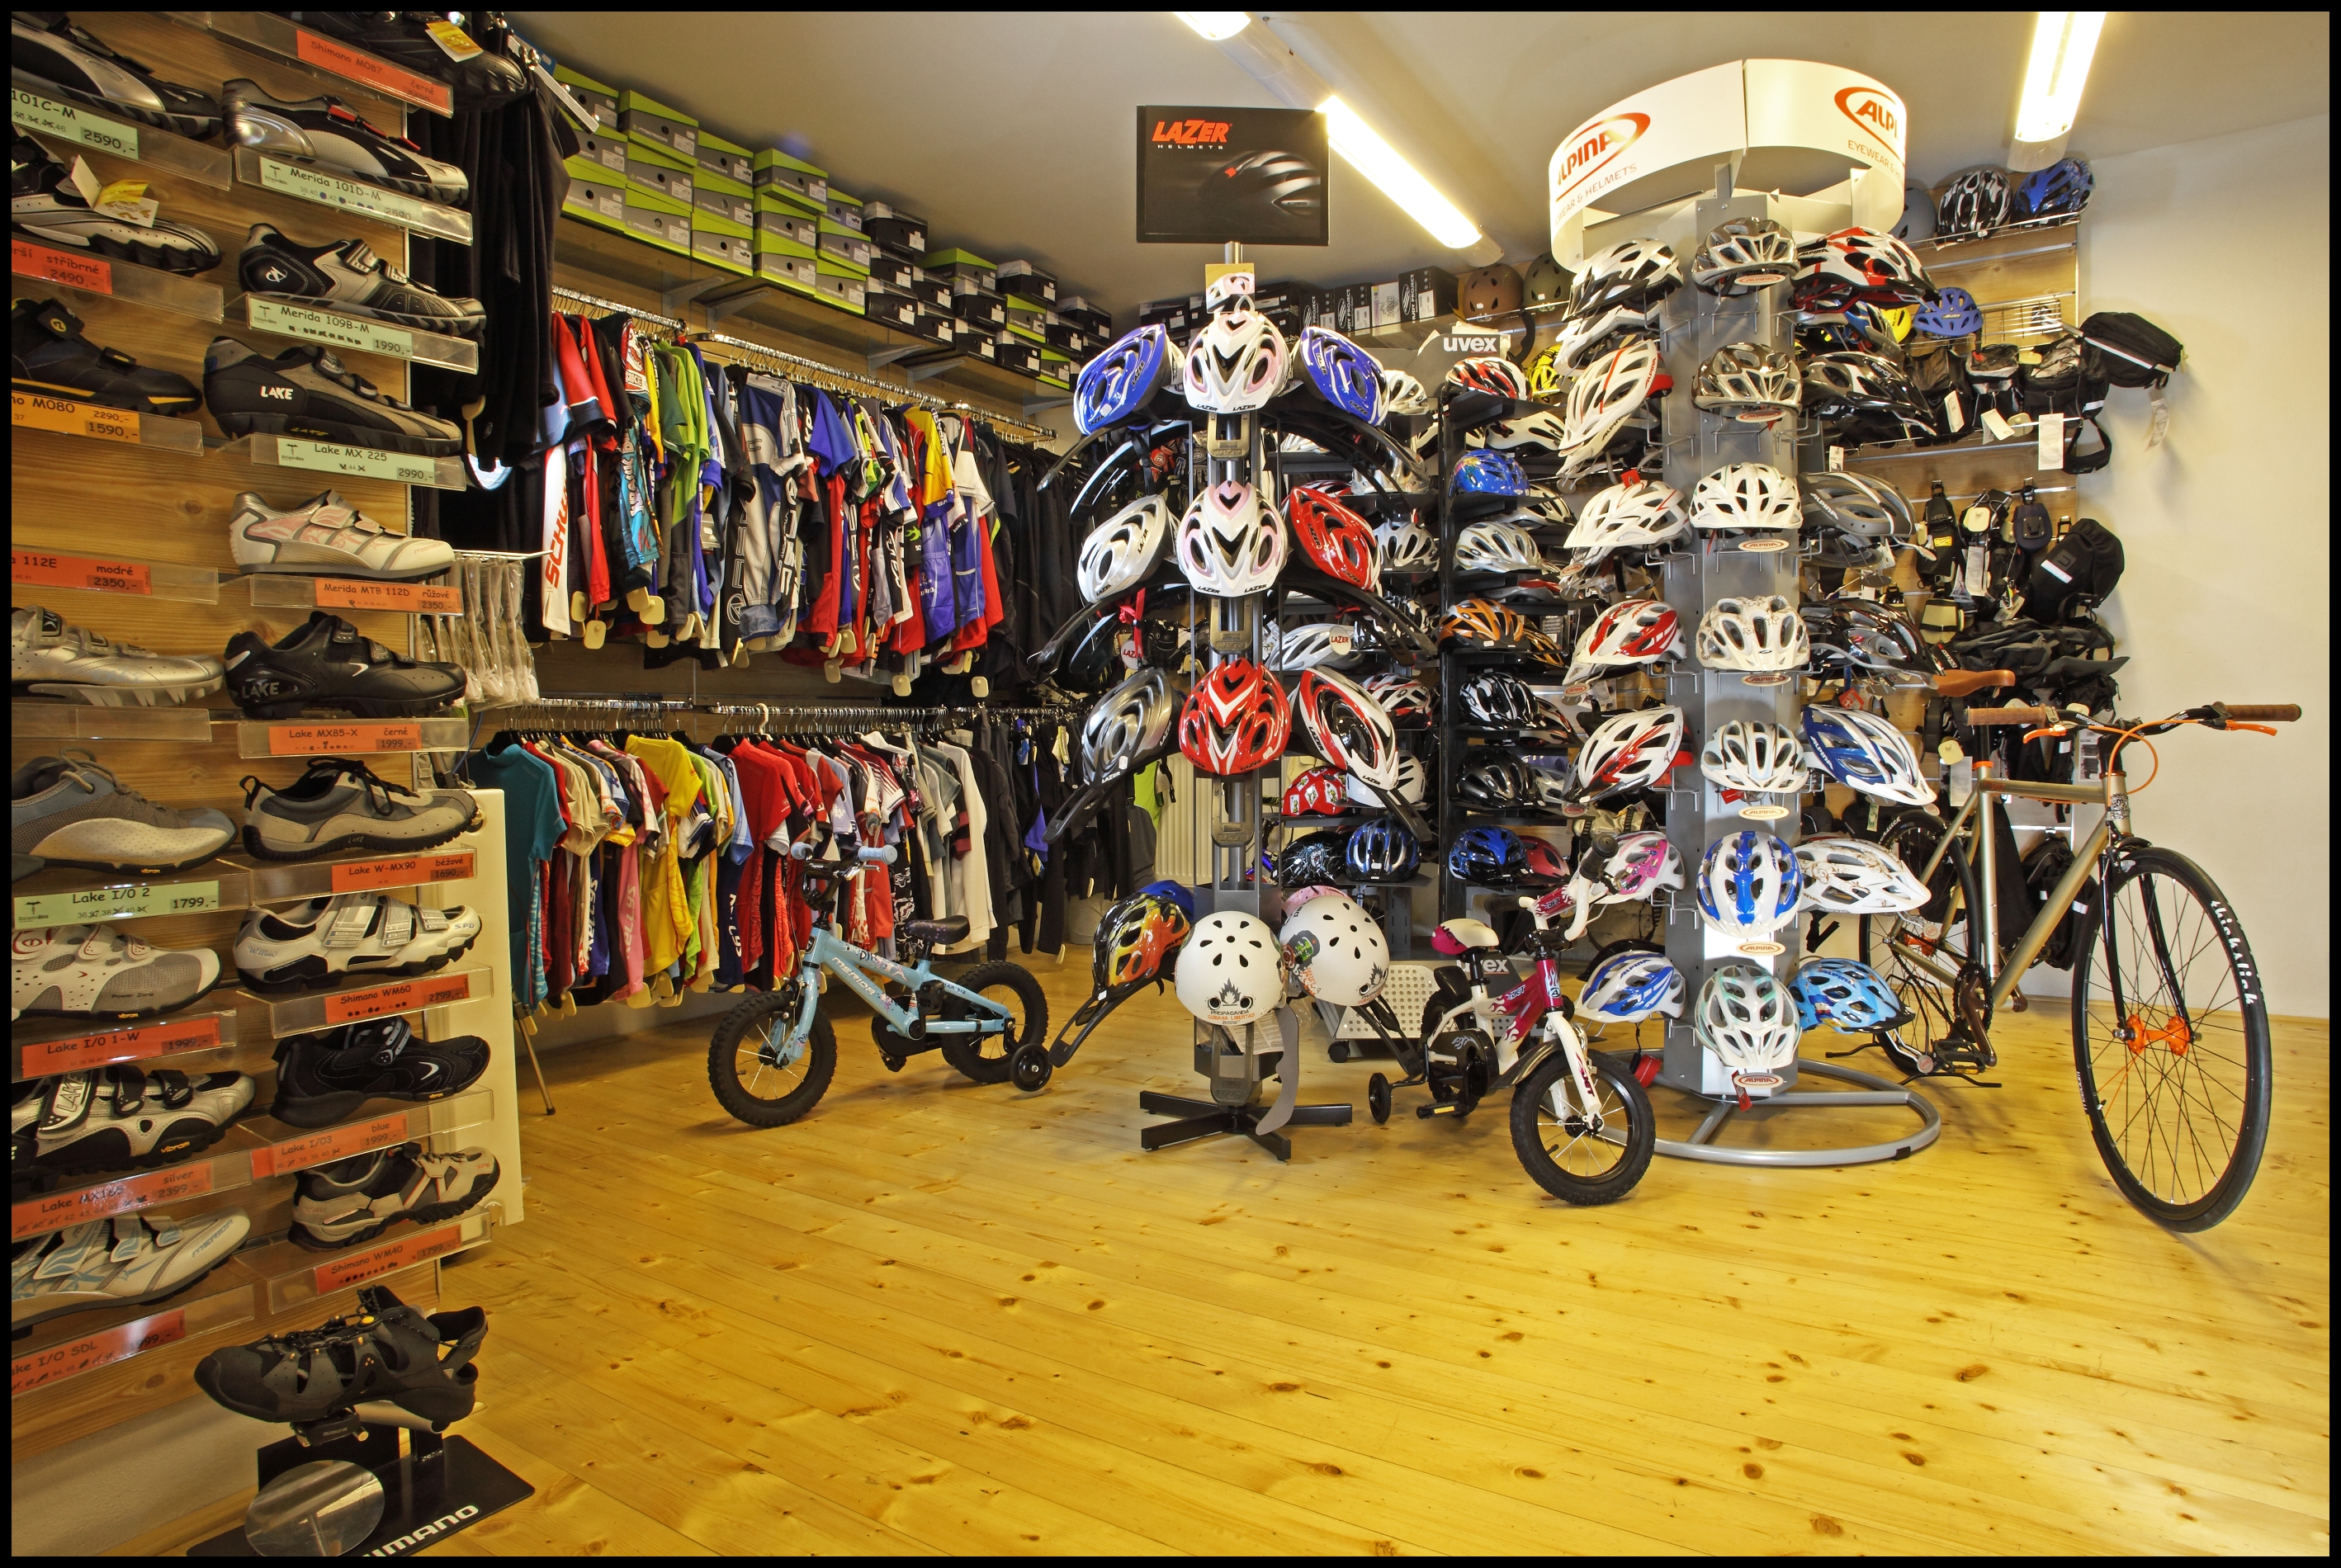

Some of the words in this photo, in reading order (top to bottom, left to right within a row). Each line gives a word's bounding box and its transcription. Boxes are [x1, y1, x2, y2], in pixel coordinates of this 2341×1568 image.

[311, 41, 352, 64] Shimano
[12, 90, 77, 120] 101C-M
[1152, 119, 1230, 144] LAZER
[84, 130, 136, 153] 2590,-
[1847, 139, 1889, 168] EYEWEAR
[290, 168, 330, 187] Merida
[335, 181, 381, 201] 101D-M
[1585, 163, 1638, 197] HELMETS
[46, 255, 100, 275] stříbrné
[50, 269, 97, 287] 2490,-
[281, 306, 321, 323] Merida
[326, 316, 370, 333] 109B-M
[375, 340, 411, 355] 1990,-
[1443, 337, 1497, 352] uvex
[1130, 360, 1147, 386] LAZER
[1644, 357, 1657, 389] ALPINA
[260, 385, 294, 399] LAKE
[1196, 403, 1218, 413] LAZER
[1232, 404, 1257, 413] LAZER
[1349, 400, 1369, 415] LAZER
[89, 423, 138, 438] 1590,-
[314, 443, 340, 456] Lake
[345, 448, 362, 459] MX
[367, 451, 387, 461] 225
[399, 468, 433, 480] 2990,-
[1809, 493, 1839, 521] ALPINA
[1137, 527, 1149, 555] LAZER
[1307, 522, 1322, 548] LAZER
[24, 556, 57, 568] 112E
[97, 564, 134, 576] modré
[93, 577, 137, 590] 2350,-
[324, 583, 357, 593] Merida
[361, 586, 381, 595] MTB
[386, 588, 410, 597] 112D
[422, 589, 450, 599] růžové
[1197, 585, 1221, 594] LAZER
[1244, 583, 1267, 593] LAZER
[422, 601, 452, 611] 2350,-
[1330, 635, 1350, 644] LAZER
[242, 682, 280, 699] LAKE
[2075, 713, 2105, 728] mongoose
[2160, 713, 2189, 730] monose
[289, 730, 313, 739] Lake
[317, 729, 358, 738] MX85-X
[384, 727, 409, 736] černé
[1308, 725, 1325, 752] LAZER
[381, 739, 412, 749] 1999,-
[1810, 735, 1833, 769] ALPINA
[1100, 770, 1121, 784] LAZER
[1362, 774, 1381, 786] LAZER
[349, 867, 371, 876] Lake
[375, 862, 416, 872] W-MX90
[436, 857, 464, 867] béžové
[435, 869, 465, 878] 1690,-
[73, 892, 106, 904] Lake
[111, 889, 136, 900] I/O
[142, 888, 150, 897] 2
[173, 897, 217, 909] 1799,-
[1804, 891, 1822, 904] INA
[729, 893, 742, 957] KLYS
[1457, 959, 1508, 972] uex
[1620, 959, 1653, 979] ALPINA
[831, 956, 876, 997] MERIDA
[1819, 969, 1854, 985] ALPINA
[340, 992, 378, 1004] Shimano
[381, 985, 411, 996] WM60
[429, 990, 461, 1002] 2799,-
[47, 1042, 78, 1055] Lake
[83, 1037, 106, 1048] I/O
[112, 1032, 140, 1044] 1-W
[168, 1038, 208, 1051] 1999,-
[56, 1072, 84, 1113] LAKE
[281, 1143, 305, 1155] Lake
[371, 1122, 390, 1133] blue
[366, 1134, 398, 1145] 1999,-
[160, 1141, 191, 1154] vibram
[41, 1200, 73, 1213] Lake
[163, 1170, 194, 1184] silver
[158, 1183, 199, 1198] 2399,-
[191, 1219, 234, 1259] MERIDA
[331, 1256, 371, 1274] Shimano
[373, 1245, 404, 1260] WM40
[422, 1244, 452, 1258] 1799,-
[12, 1363, 31, 1377] ake
[38, 1351, 64, 1367] I/O
[71, 1341, 98, 1357] SDL
[362, 1504, 480, 1556] IMANO
